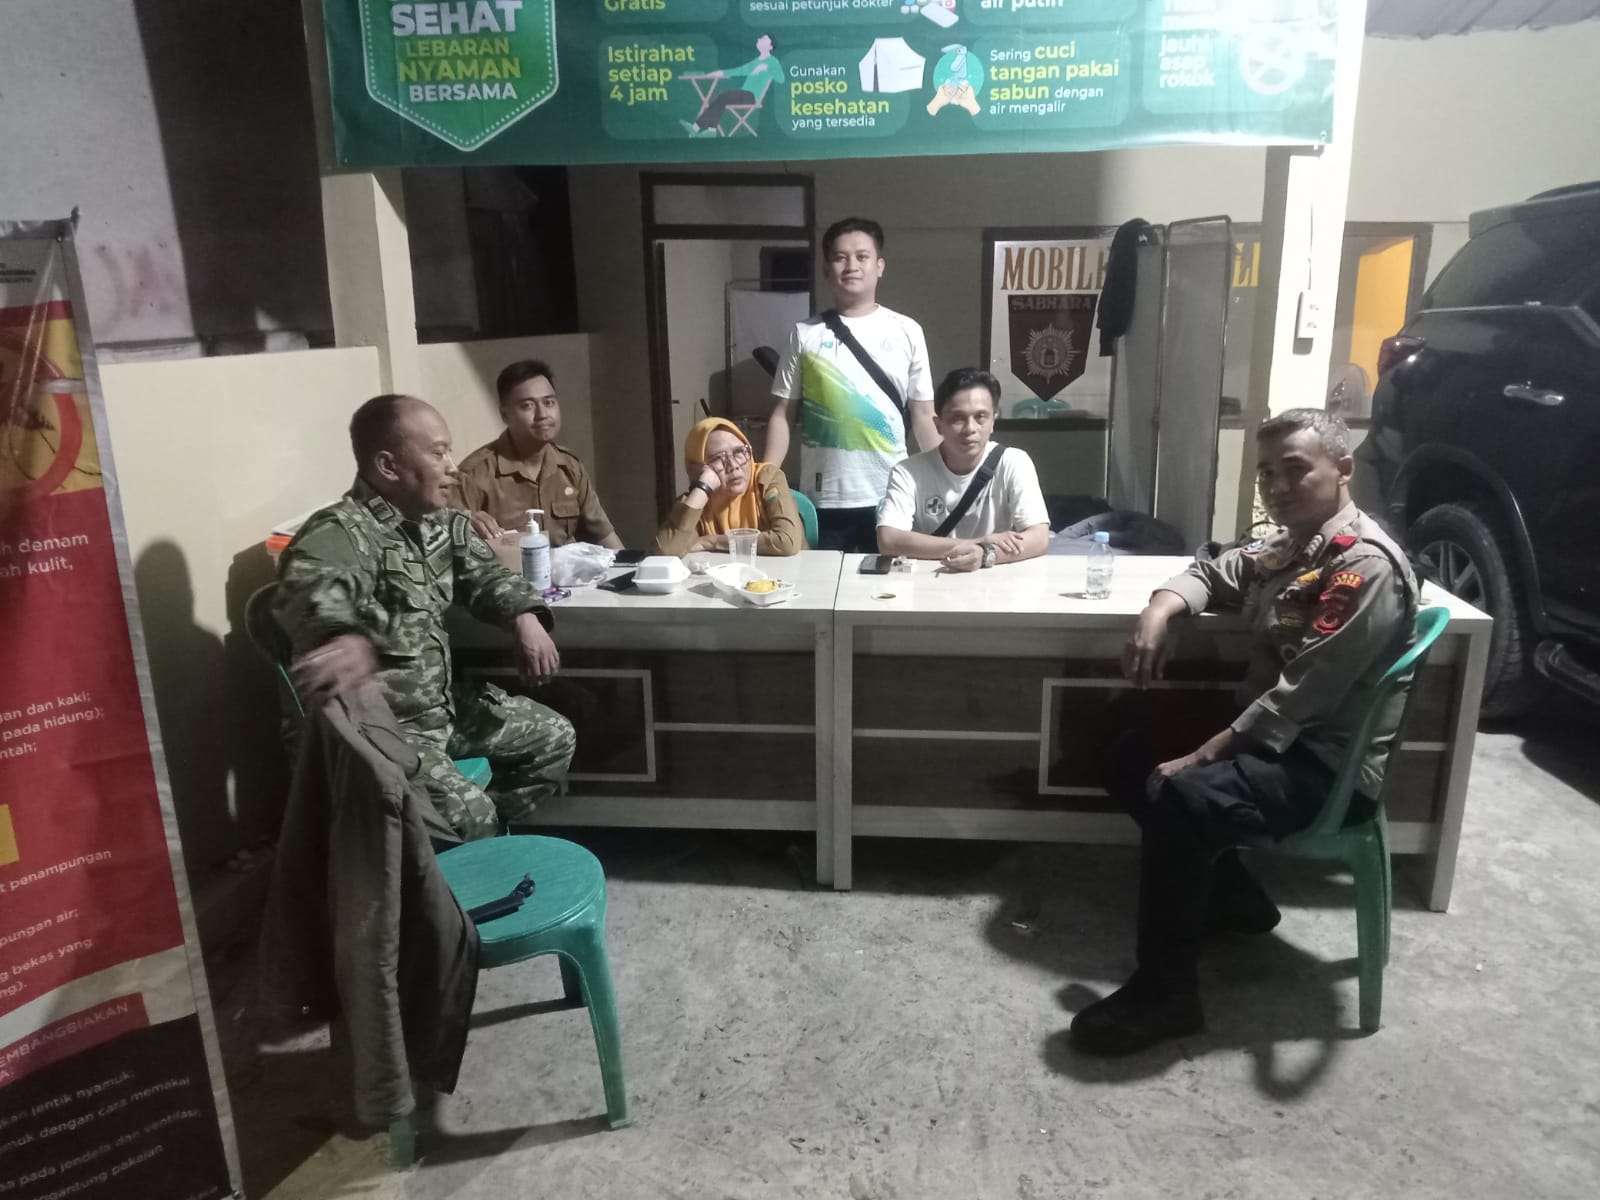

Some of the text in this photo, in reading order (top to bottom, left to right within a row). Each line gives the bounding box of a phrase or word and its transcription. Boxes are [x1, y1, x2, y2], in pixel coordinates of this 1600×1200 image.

[749, 0, 788, 12] sesuai
[791, 0, 849, 12] petunjuk
[391, 1, 523, 36] SEHAT
[405, 37, 510, 57] LEBARAN
[608, 44, 695, 63] Istirahat
[990, 41, 1076, 63] Sering cuci
[399, 57, 522, 82] NYAMAN
[608, 64, 673, 85] setiap
[789, 65, 846, 77] Gunakan
[990, 59, 1120, 83] tangan pakai
[409, 82, 518, 103] BERSAMA
[609, 84, 668, 106] 4 jam
[790, 77, 848, 98] posko
[990, 84, 1104, 101] sabun dengan
[791, 98, 890, 116] kesehatan
[989, 100, 1066, 116] air mengalir
[791, 115, 876, 131] yang tersedia
[18, 533, 89, 553] demam
[27, 556, 74, 575] kulit,
[26, 703, 54, 716] dan
[2, 706, 104, 742] pada hidung);
[10, 850, 113, 892] penampungan
[12, 937, 94, 976] bekas yang
[31, 1093, 73, 1117] jentik
[39, 1112, 95, 1139] dengan
[130, 1076, 191, 1102] memakai
[111, 1144, 164, 1176] pakaian
[20, 1166, 57, 1187] pada
